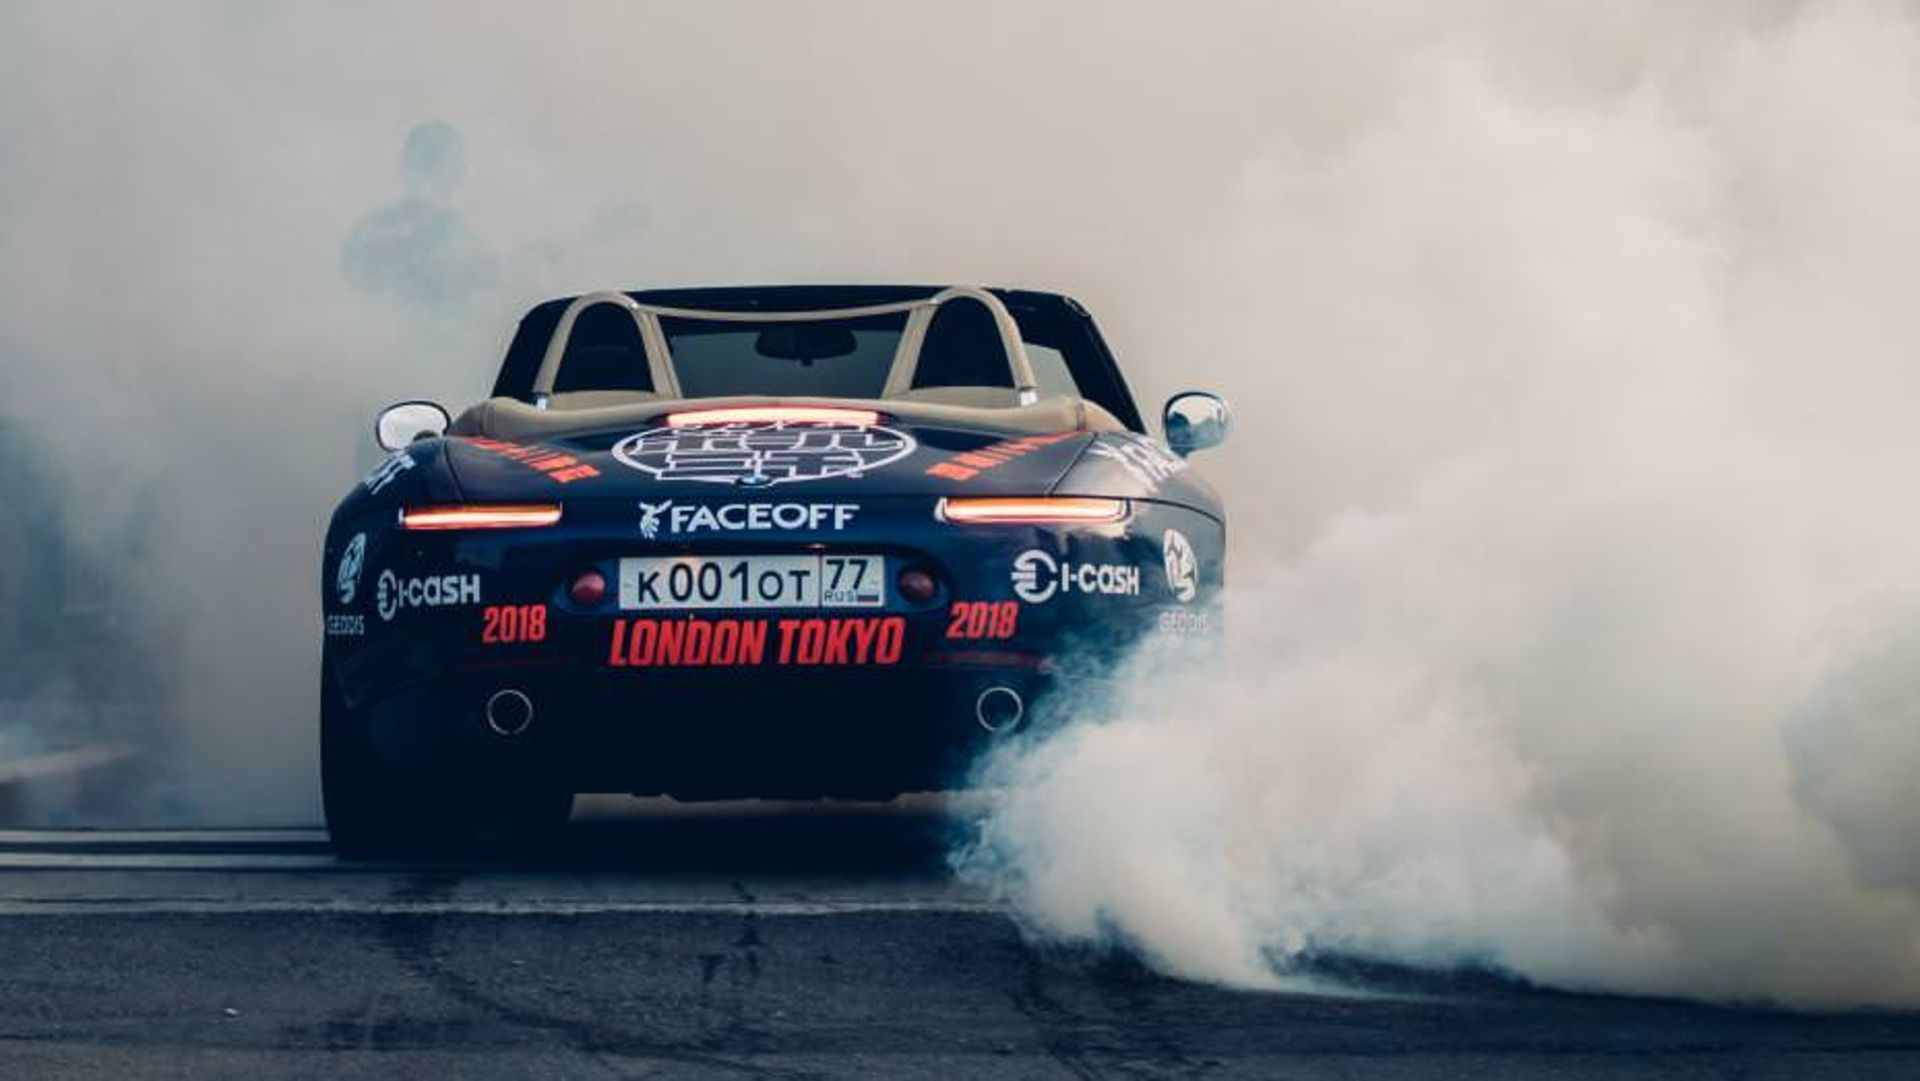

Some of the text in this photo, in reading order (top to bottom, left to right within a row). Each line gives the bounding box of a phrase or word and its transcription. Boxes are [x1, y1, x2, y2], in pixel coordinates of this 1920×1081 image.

[670, 503, 861, 533] FACEOFF
[826, 558, 868, 590] 77
[824, 590, 853, 602] RUS
[482, 604, 547, 643] 2018
[946, 602, 1019, 638] 2018
[609, 617, 907, 667] LONDON TOKYO
